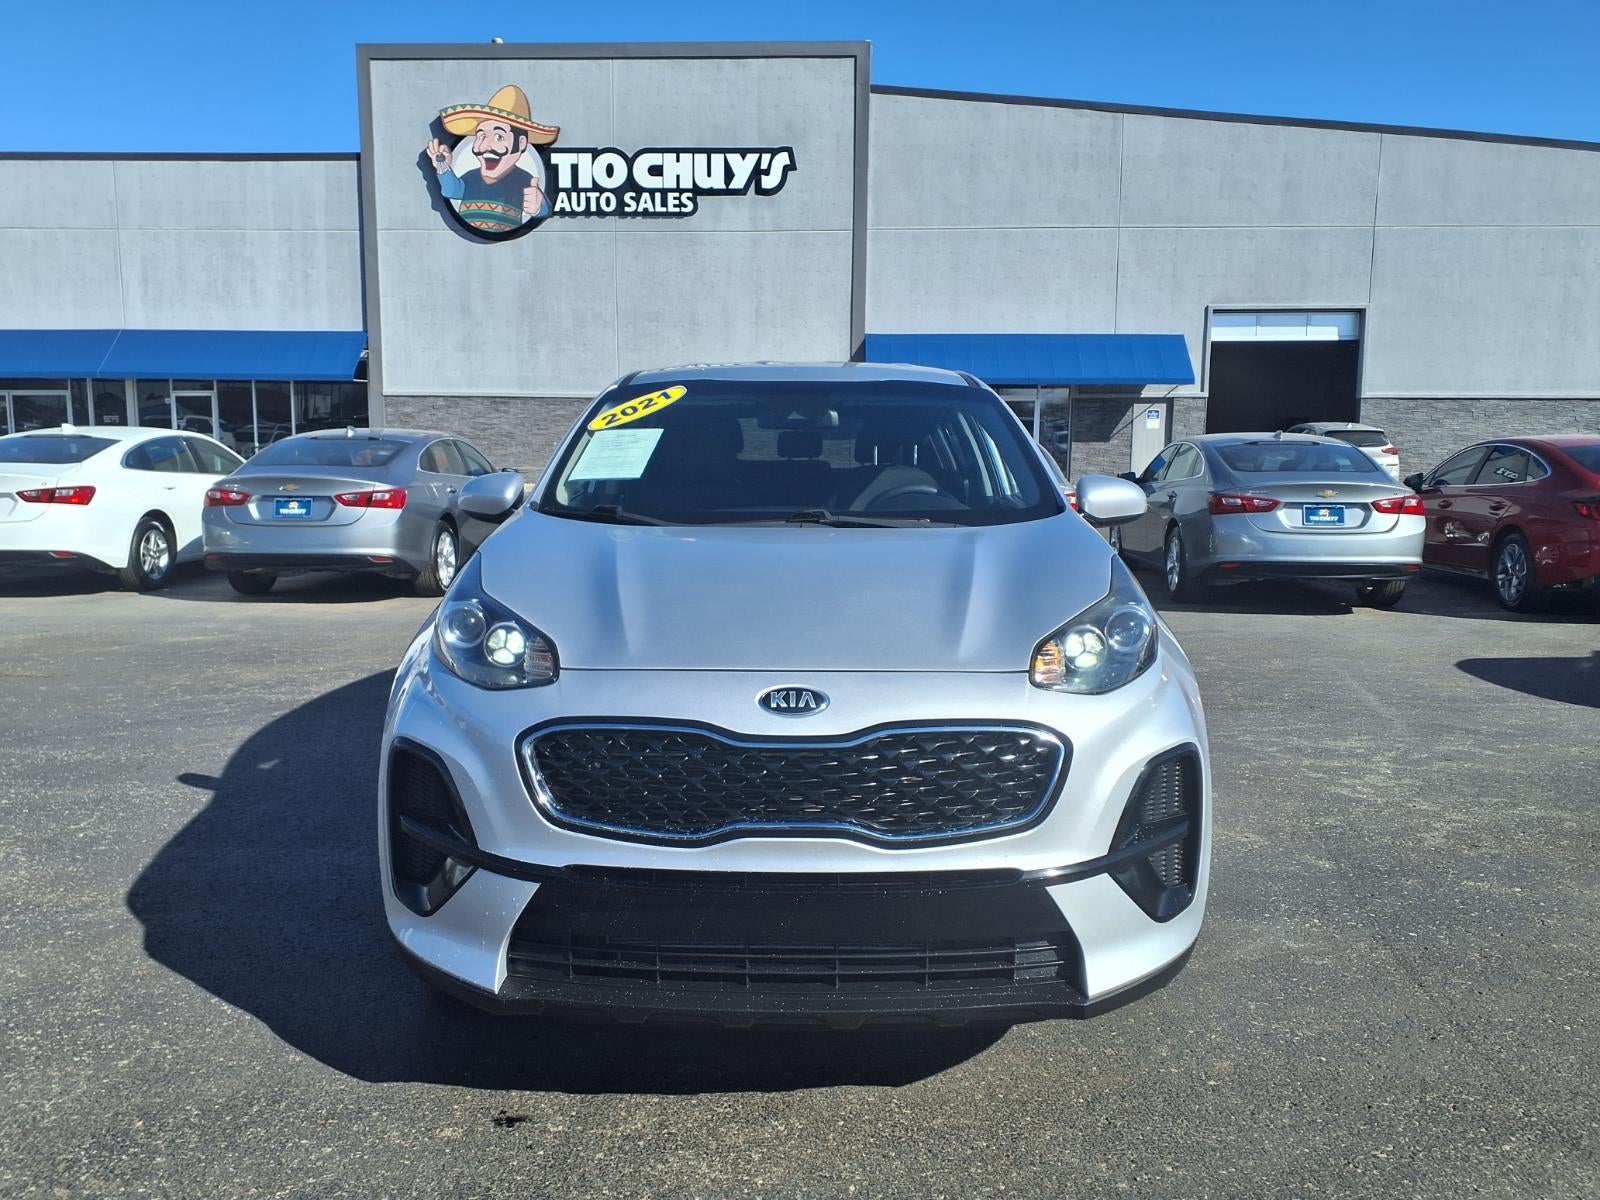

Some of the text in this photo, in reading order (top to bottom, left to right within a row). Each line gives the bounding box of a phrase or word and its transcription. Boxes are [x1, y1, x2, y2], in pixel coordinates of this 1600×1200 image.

[551, 151, 791, 189] TIO CHUY'S
[554, 191, 694, 212] AUTO SALES
[601, 391, 672, 426] 2021
[770, 690, 817, 708] KIA
